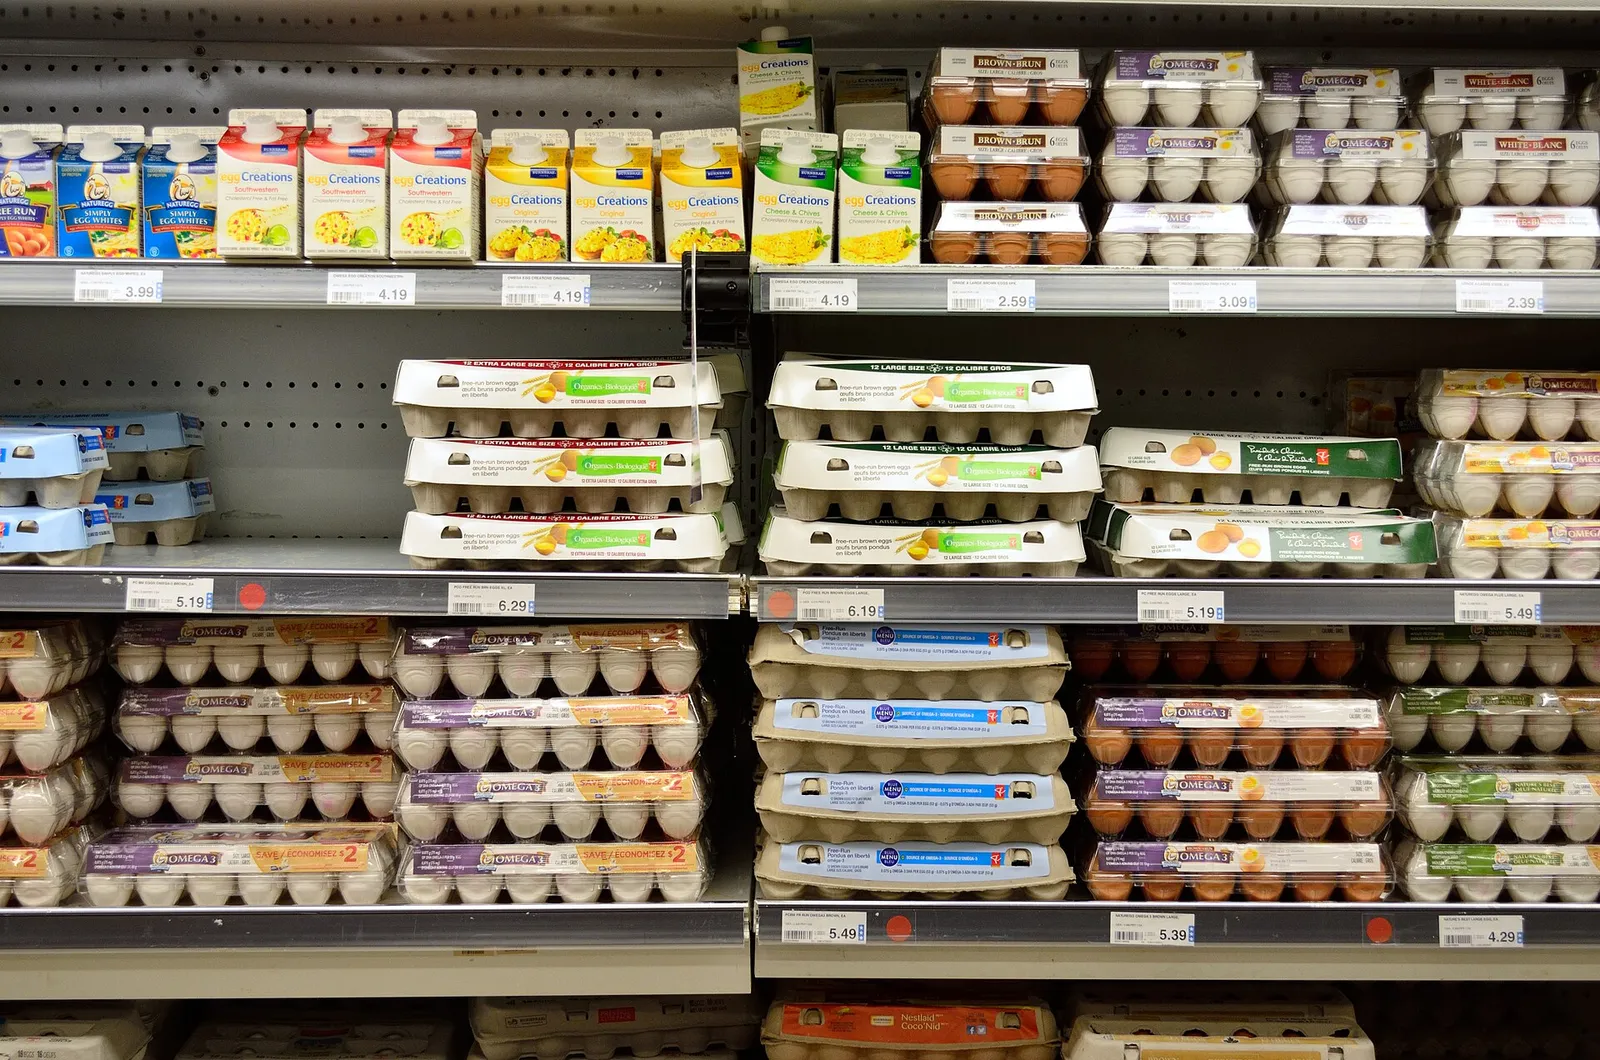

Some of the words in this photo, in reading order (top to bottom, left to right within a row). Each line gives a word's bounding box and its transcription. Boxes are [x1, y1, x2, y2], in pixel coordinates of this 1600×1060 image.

[750, 71, 773, 79] Cheese
[81, 200, 114, 208] NATUREGG
[14, 208, 36, 216] RUN
[74, 216, 91, 224] EGG
[92, 217, 122, 225] WHITES
[126, 287, 154, 298] 3.99
[378, 289, 407, 301] 4.19
[553, 291, 582, 302] 4.19
[821, 295, 849, 306] 4.19
[998, 296, 1027, 307] 2.59
[1219, 296, 1247, 308] 3.09
[1507, 296, 1535, 309] 2.39
[176, 596, 204, 608] 5.19
[498, 600, 527, 612] 6.29
[848, 605, 876, 618] 6.19
[1186, 606, 1215, 619] 5.19
[1505, 608, 1533, 620] 5.49
[256, 851, 278, 859] SAVE
[344, 846, 357, 862] 2
[583, 851, 607, 859] SAVE
[672, 846, 686, 863] 2
[829, 928, 856, 940] 5.49
[1159, 929, 1187, 941] 5.39
[1488, 931, 1515, 942] 4.29
[901, 1022, 940, 1030] Coco'Nid
